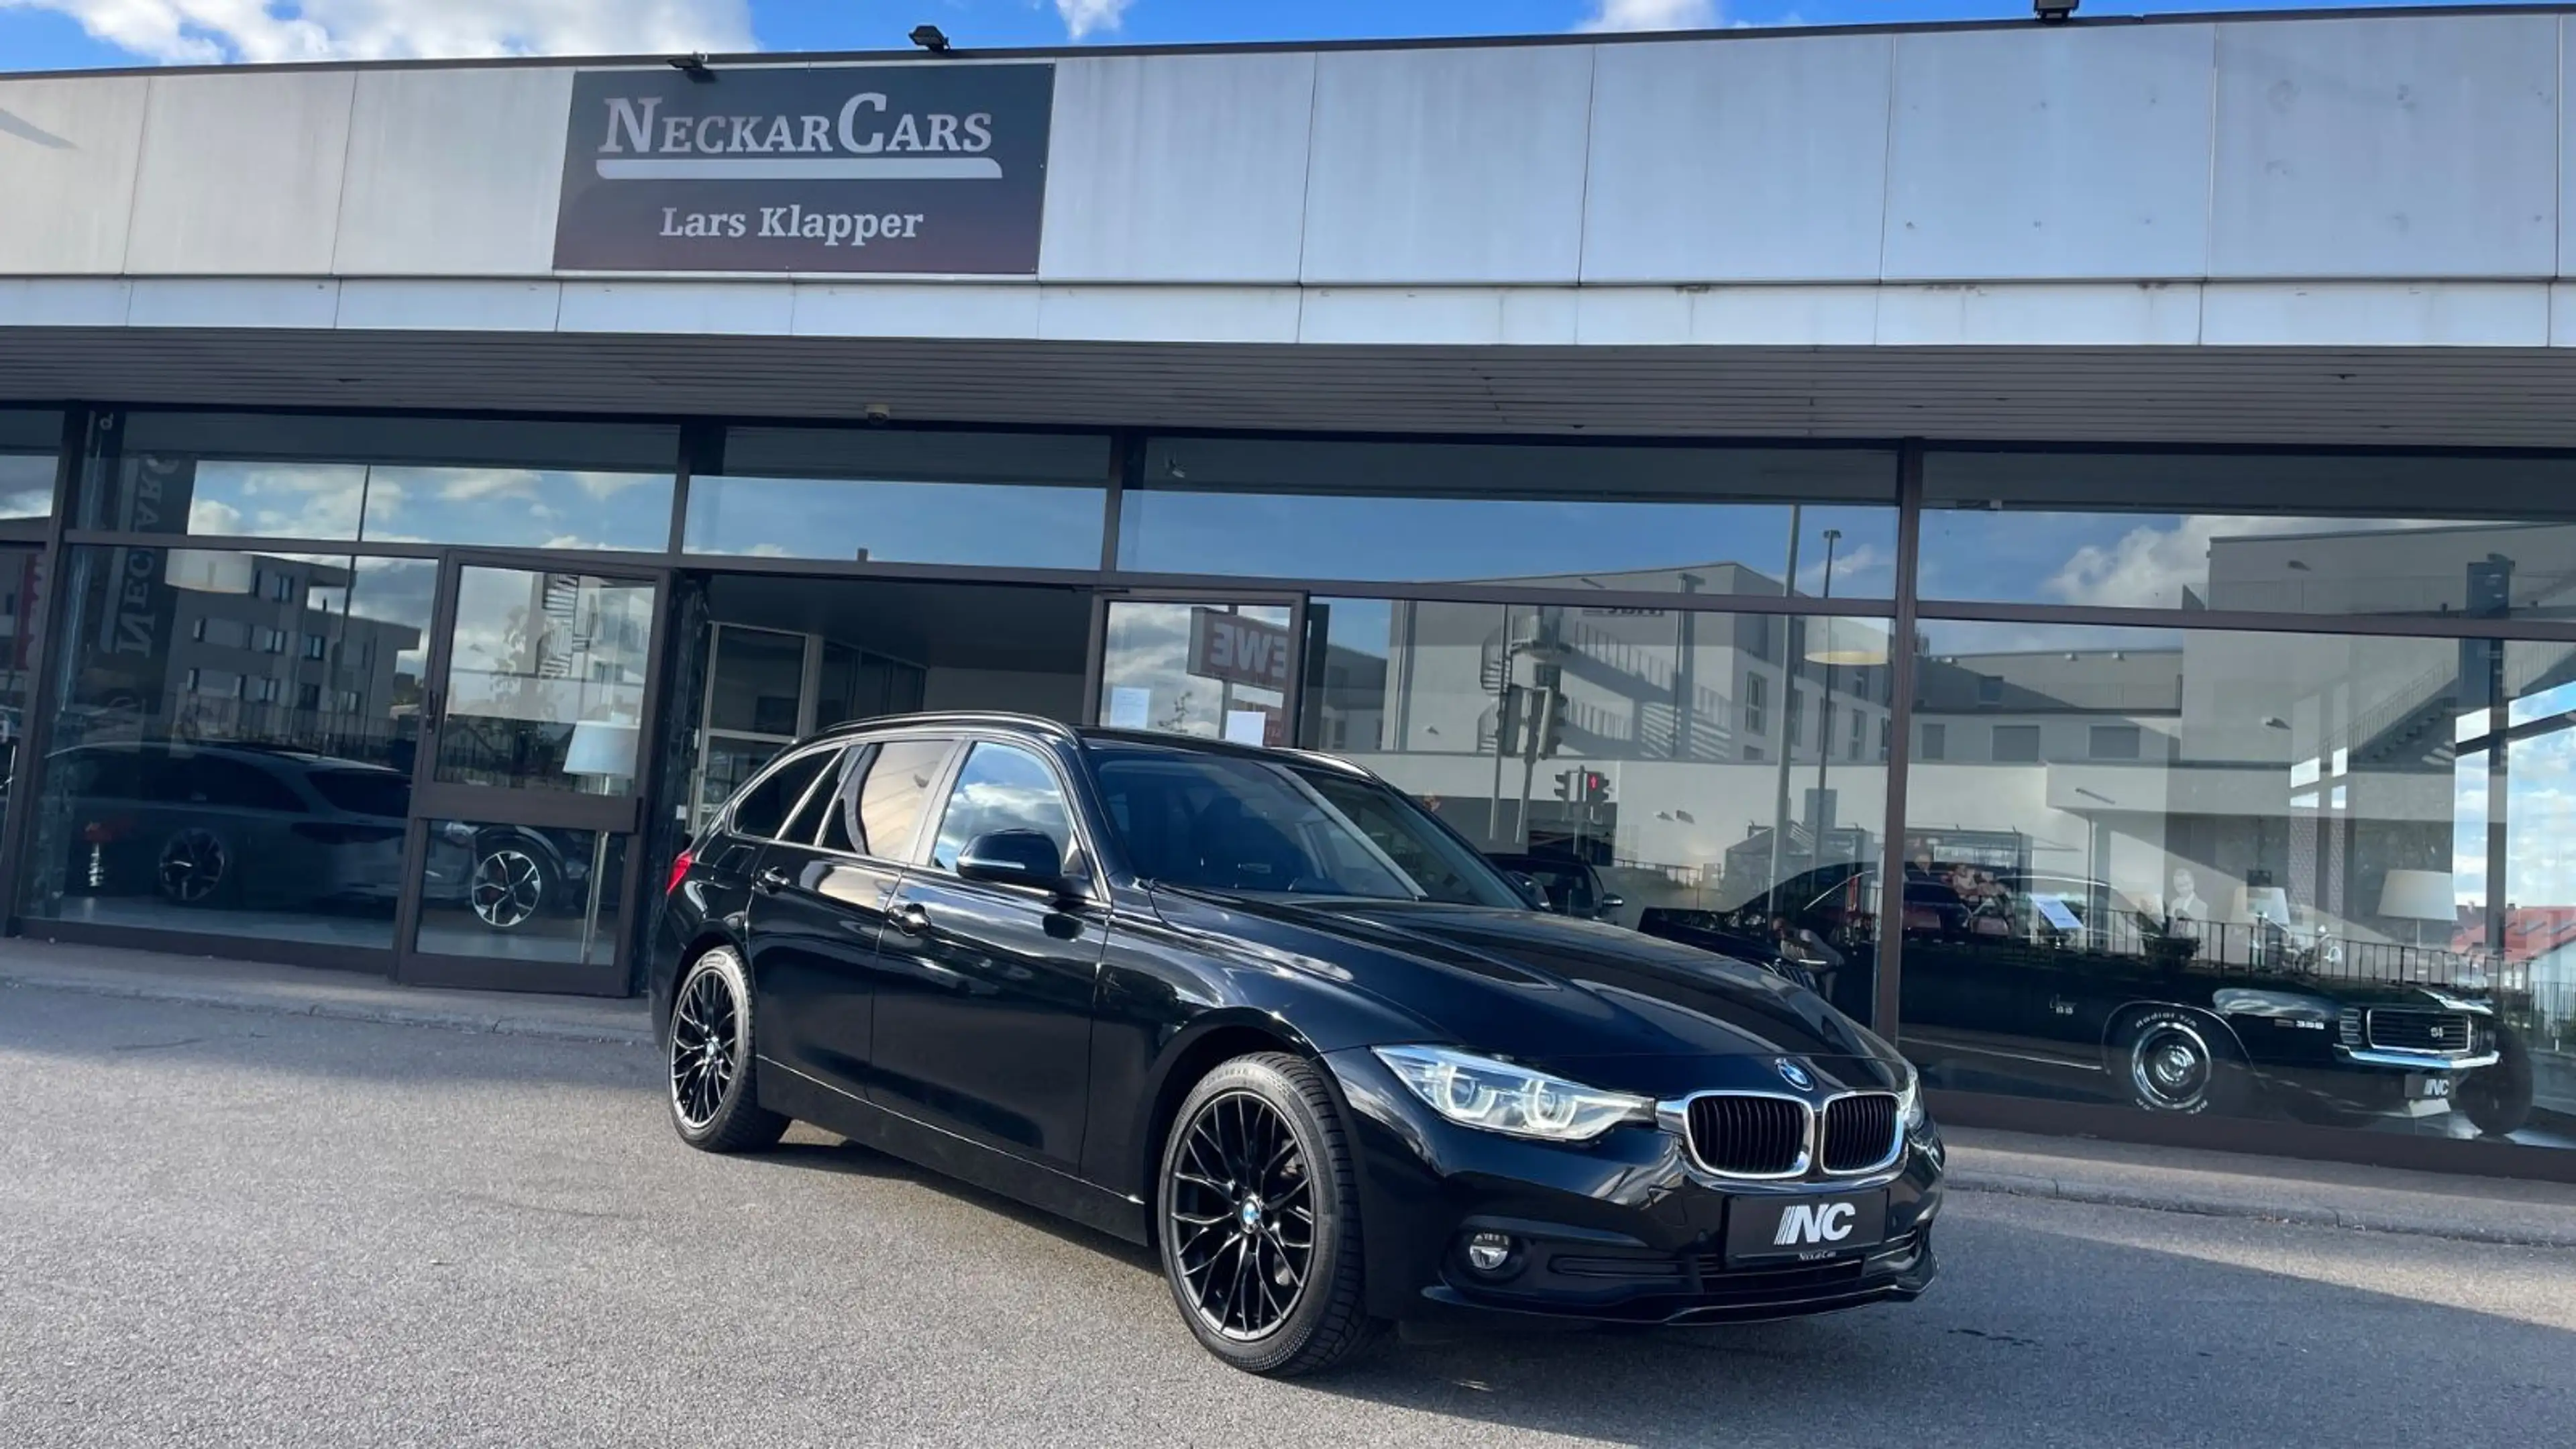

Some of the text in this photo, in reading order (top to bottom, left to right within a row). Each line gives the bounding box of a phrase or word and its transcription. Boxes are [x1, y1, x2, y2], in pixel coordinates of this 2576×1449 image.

[659, 205, 923, 246] Lars Klapper
[2424, 1079, 2449, 1095] NC
[1774, 1203, 1855, 1246] NC
